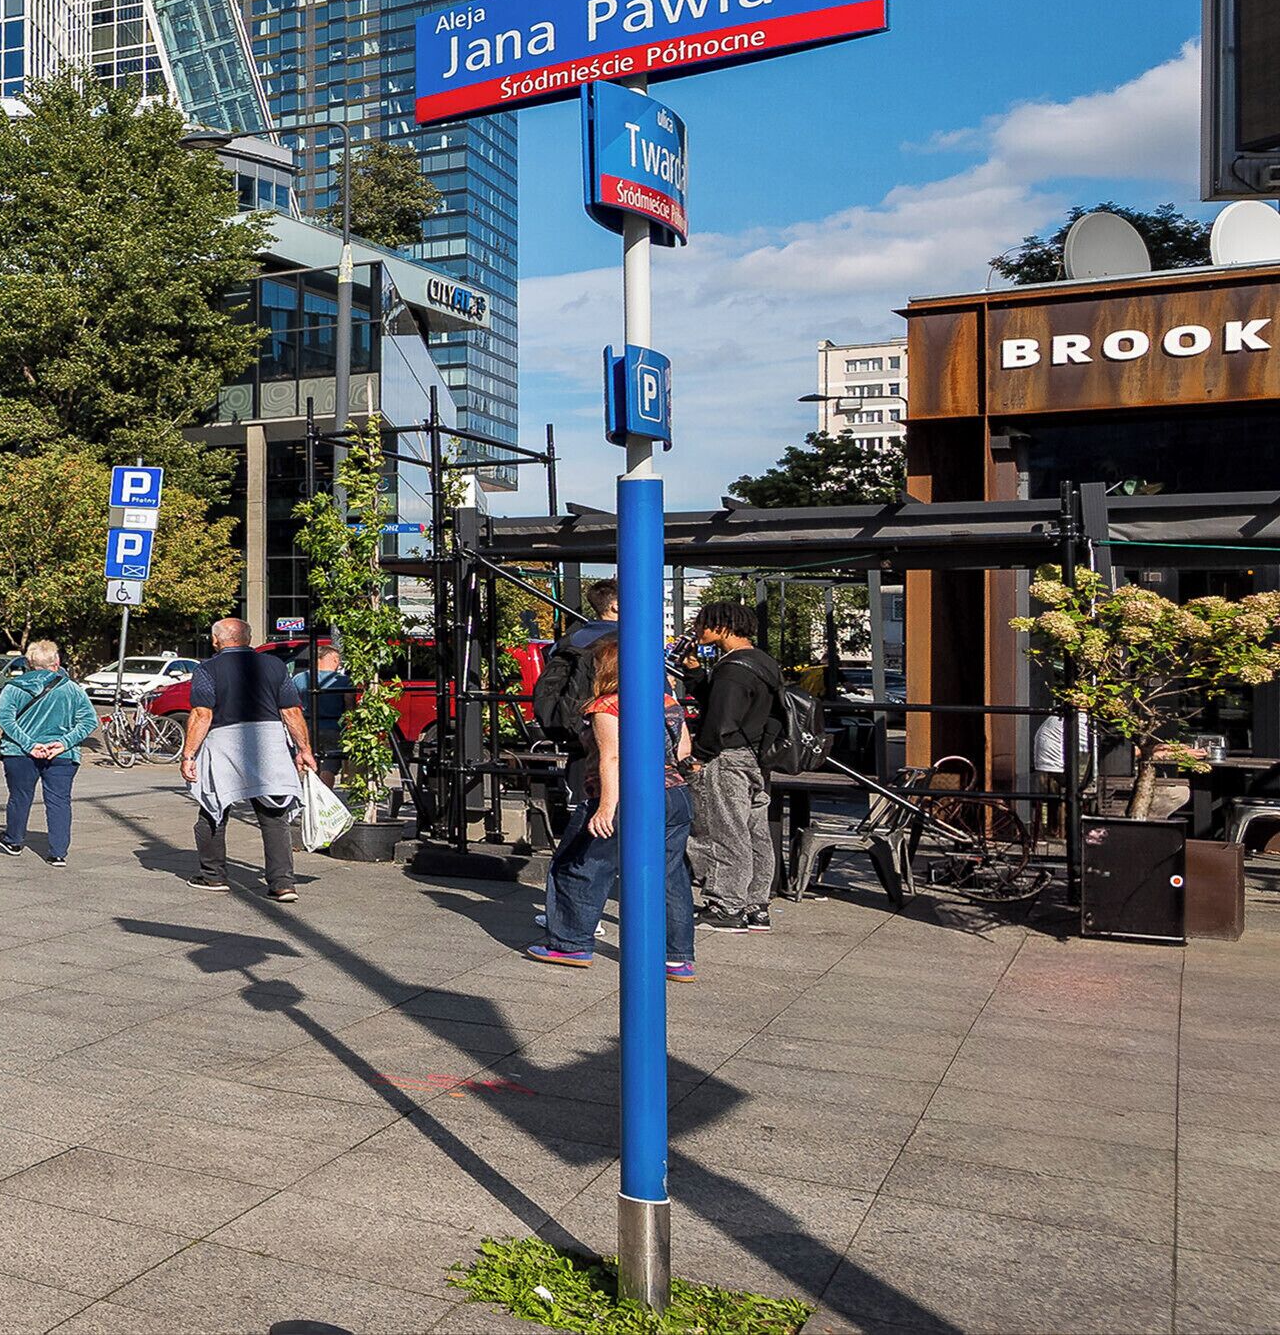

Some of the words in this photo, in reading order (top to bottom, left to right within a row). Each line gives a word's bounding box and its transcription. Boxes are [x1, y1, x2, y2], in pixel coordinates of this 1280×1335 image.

[435, 5, 486, 34] Aleja
[442, 19, 556, 79] Jana
[500, 52, 635, 100] Śródmieście
[645, 28, 766, 67] Północne
[616, 179, 671, 219] Śródmieście
[1001, 318, 1272, 369] BROOK
[643, 372, 657, 412] P
[121, 471, 152, 503] P
[115, 532, 144, 564] P
